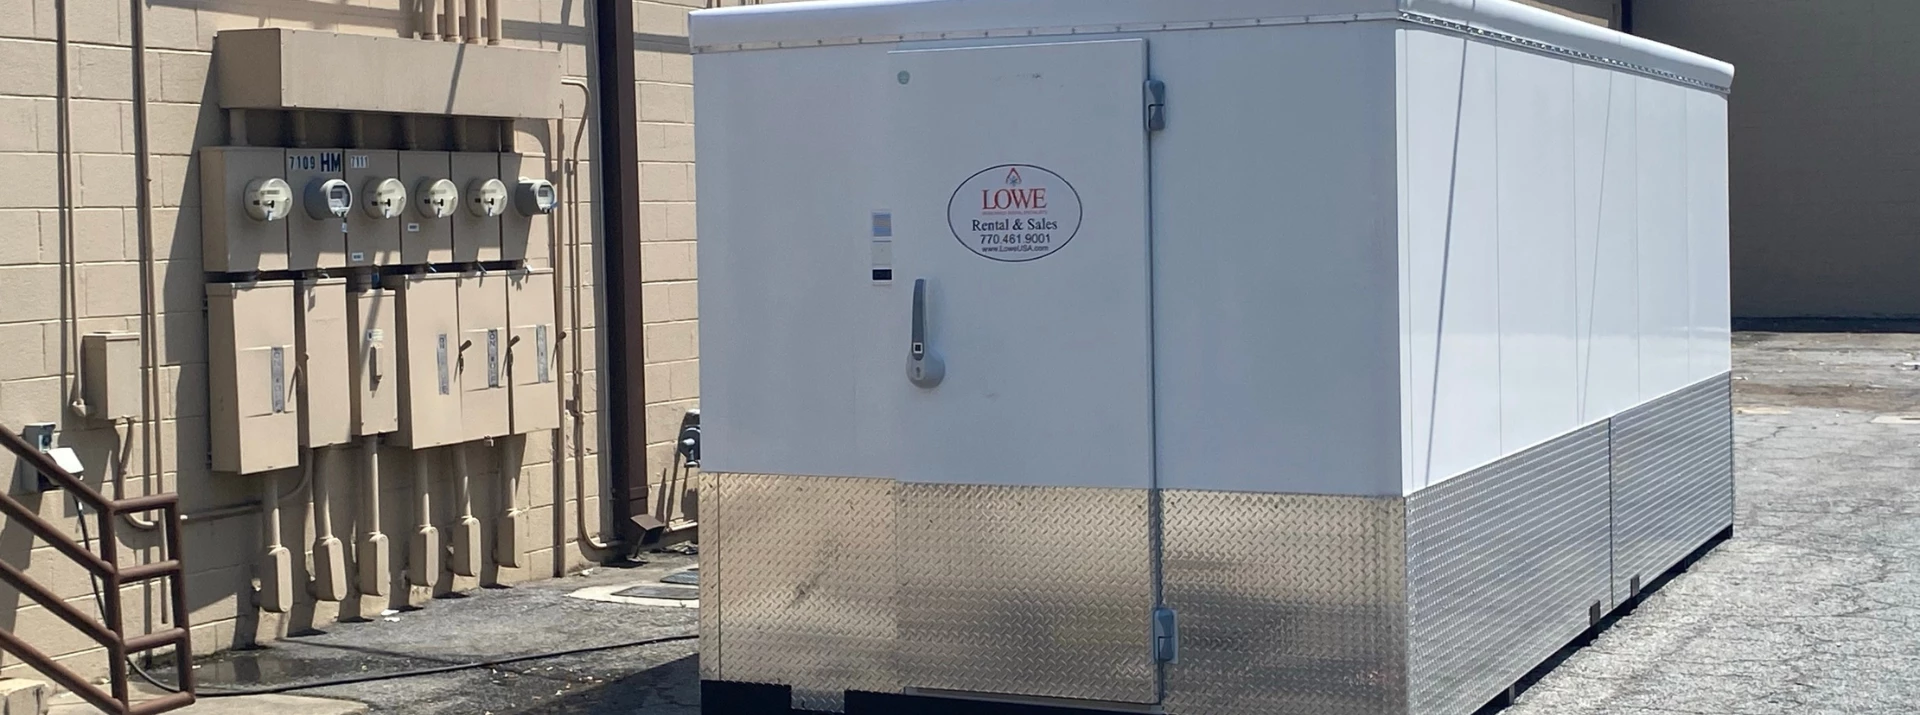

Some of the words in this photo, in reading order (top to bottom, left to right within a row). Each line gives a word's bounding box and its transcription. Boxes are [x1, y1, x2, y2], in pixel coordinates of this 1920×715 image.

[288, 155, 316, 170] 7109
[320, 152, 341, 173] HM
[982, 188, 1047, 209] LOWE
[972, 219, 1009, 231] Rental
[1012, 218, 1023, 231] &
[1027, 218, 1058, 230] Sales
[980, 233, 1051, 245] 770.461.9001
